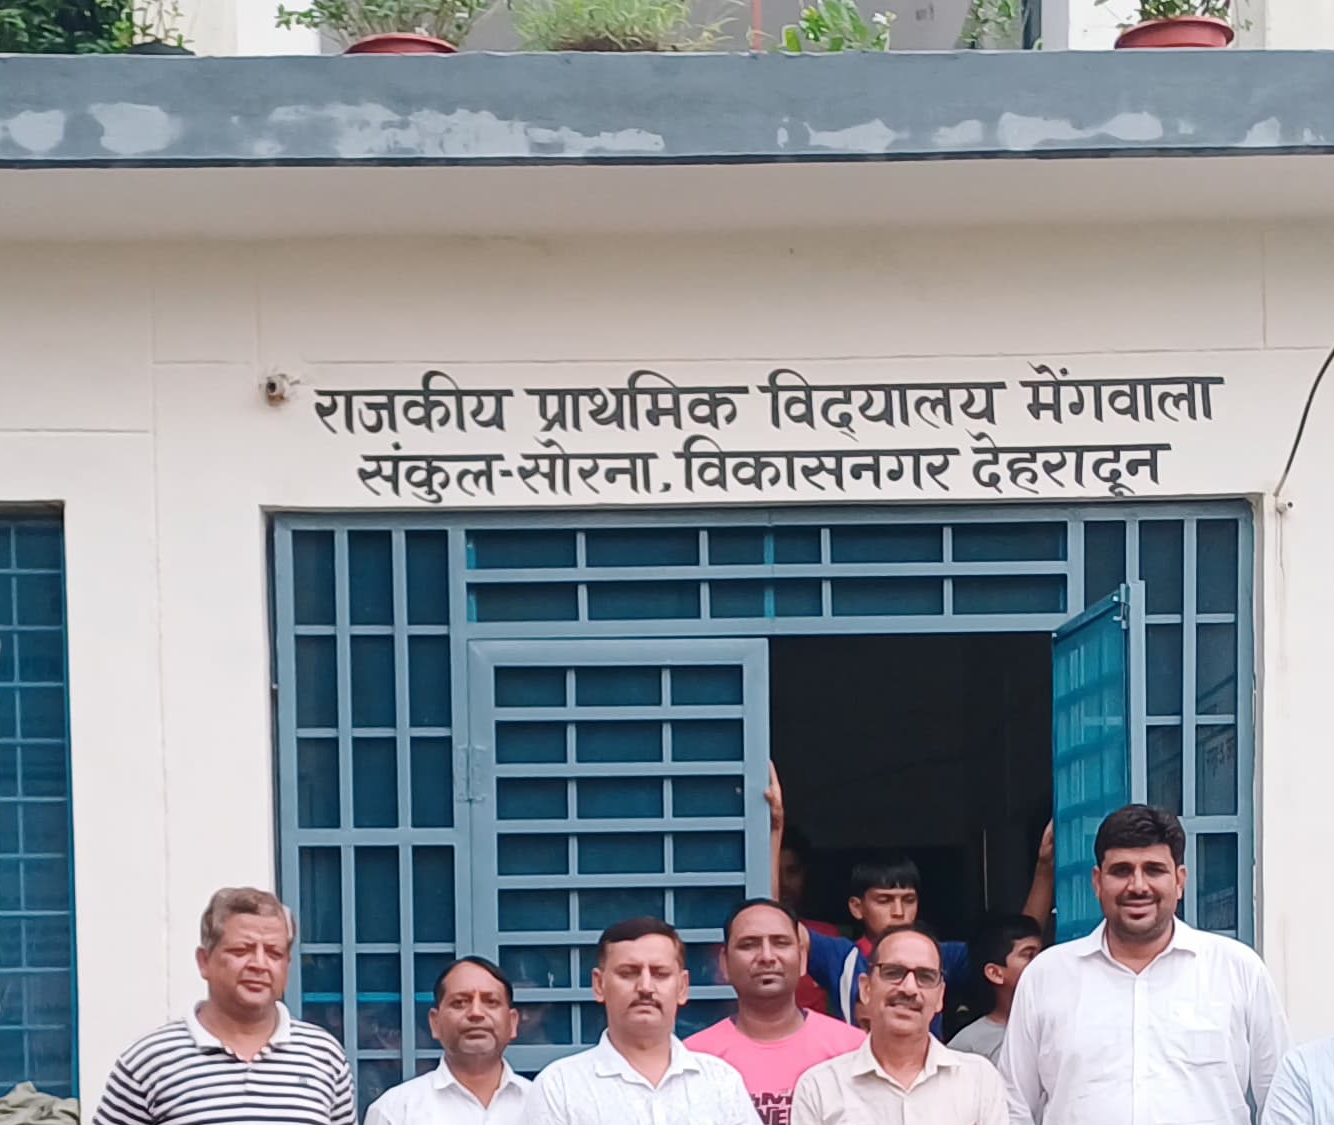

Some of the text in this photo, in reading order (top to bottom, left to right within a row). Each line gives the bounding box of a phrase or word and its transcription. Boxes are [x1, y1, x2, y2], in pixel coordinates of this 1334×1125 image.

[314, 362, 1225, 442] राजकीय प्राथमिक विद्यालय मेंगवाला
[672, 434, 960, 496] विकासनगर
[966, 430, 1171, 498] देहरादून
